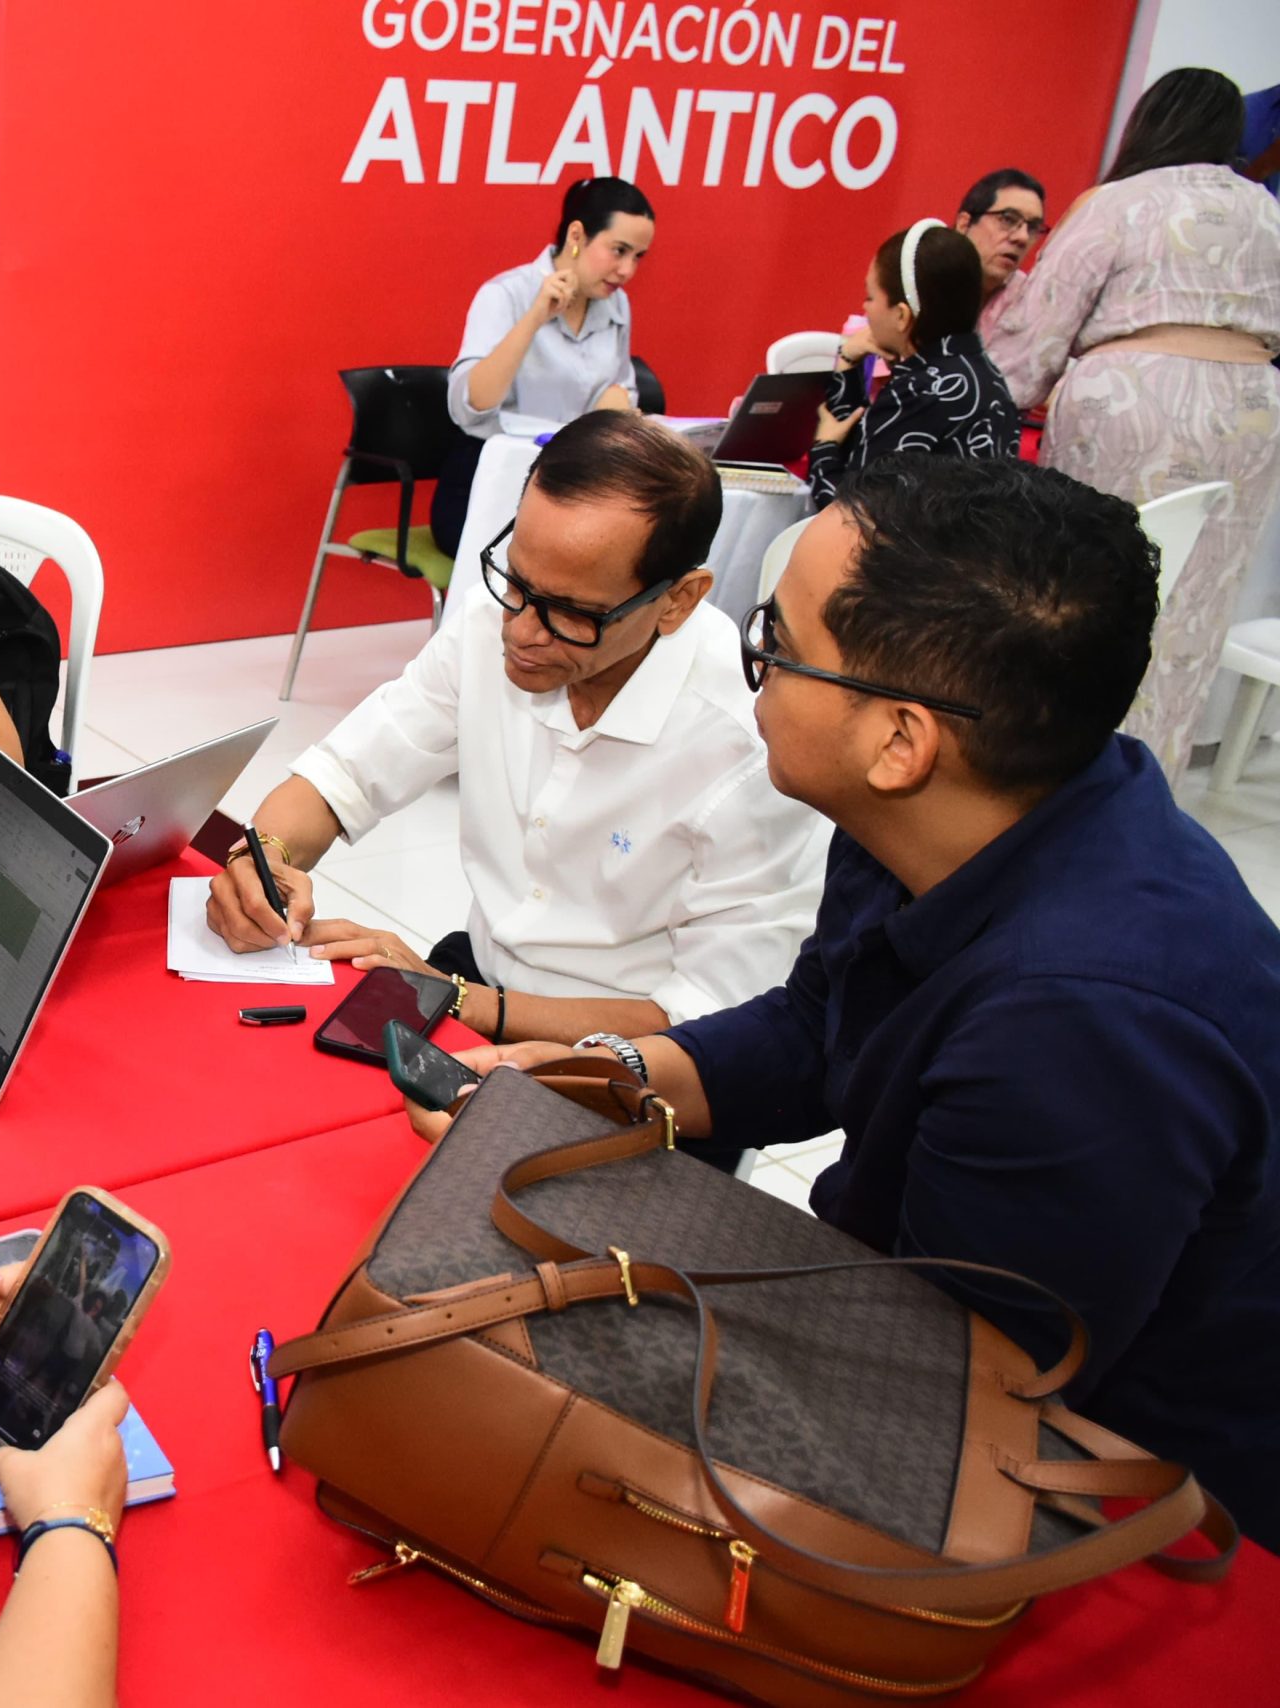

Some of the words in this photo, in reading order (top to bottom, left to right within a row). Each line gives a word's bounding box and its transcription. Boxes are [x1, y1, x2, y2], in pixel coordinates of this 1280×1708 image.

[362, 0, 800, 67] GOBERNACIÓN
[813, 15, 905, 73] DEL
[341, 57, 898, 190] ATLÁNTICO
